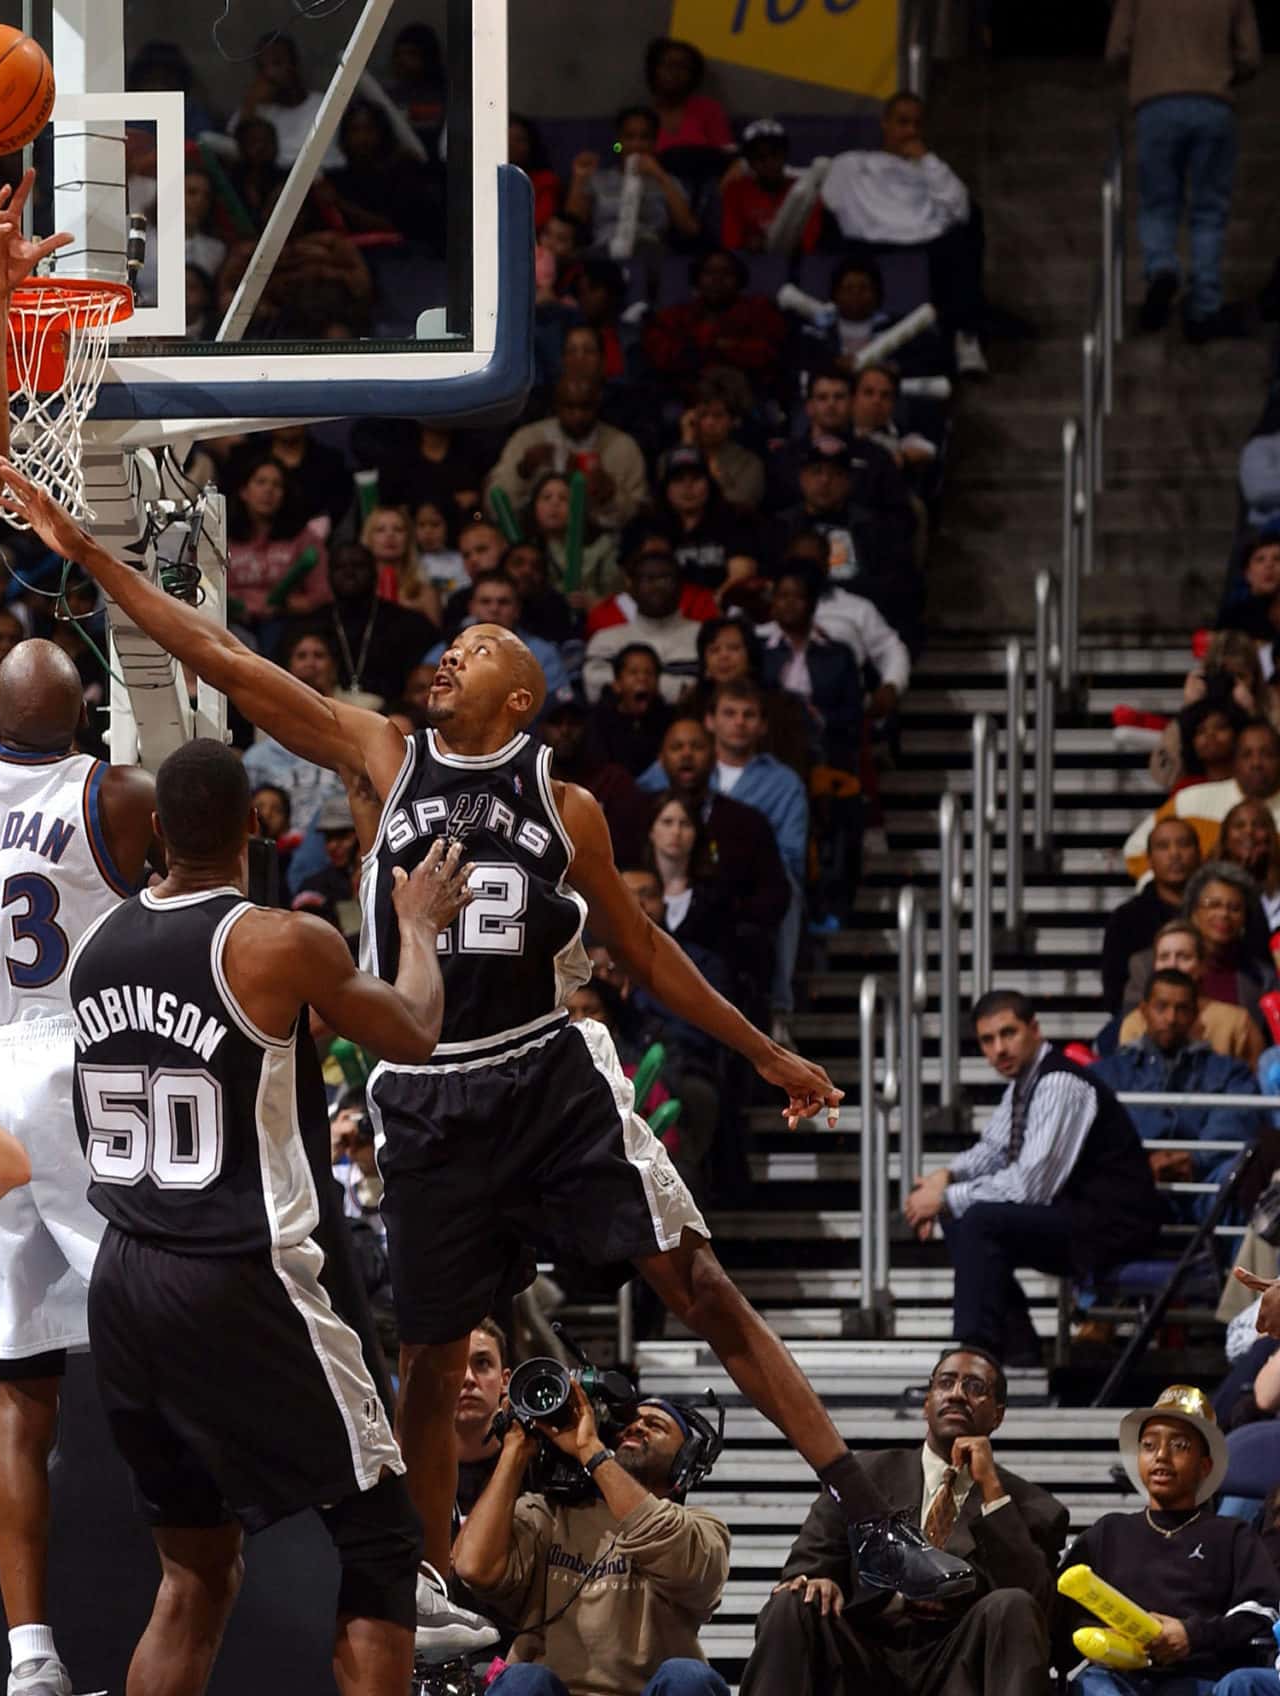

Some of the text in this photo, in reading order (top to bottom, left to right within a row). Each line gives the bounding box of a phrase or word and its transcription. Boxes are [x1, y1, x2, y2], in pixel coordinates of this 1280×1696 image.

[386, 793, 553, 859] SPURS
[436, 861, 529, 956] 2
[77, 1062, 224, 1190] 50
